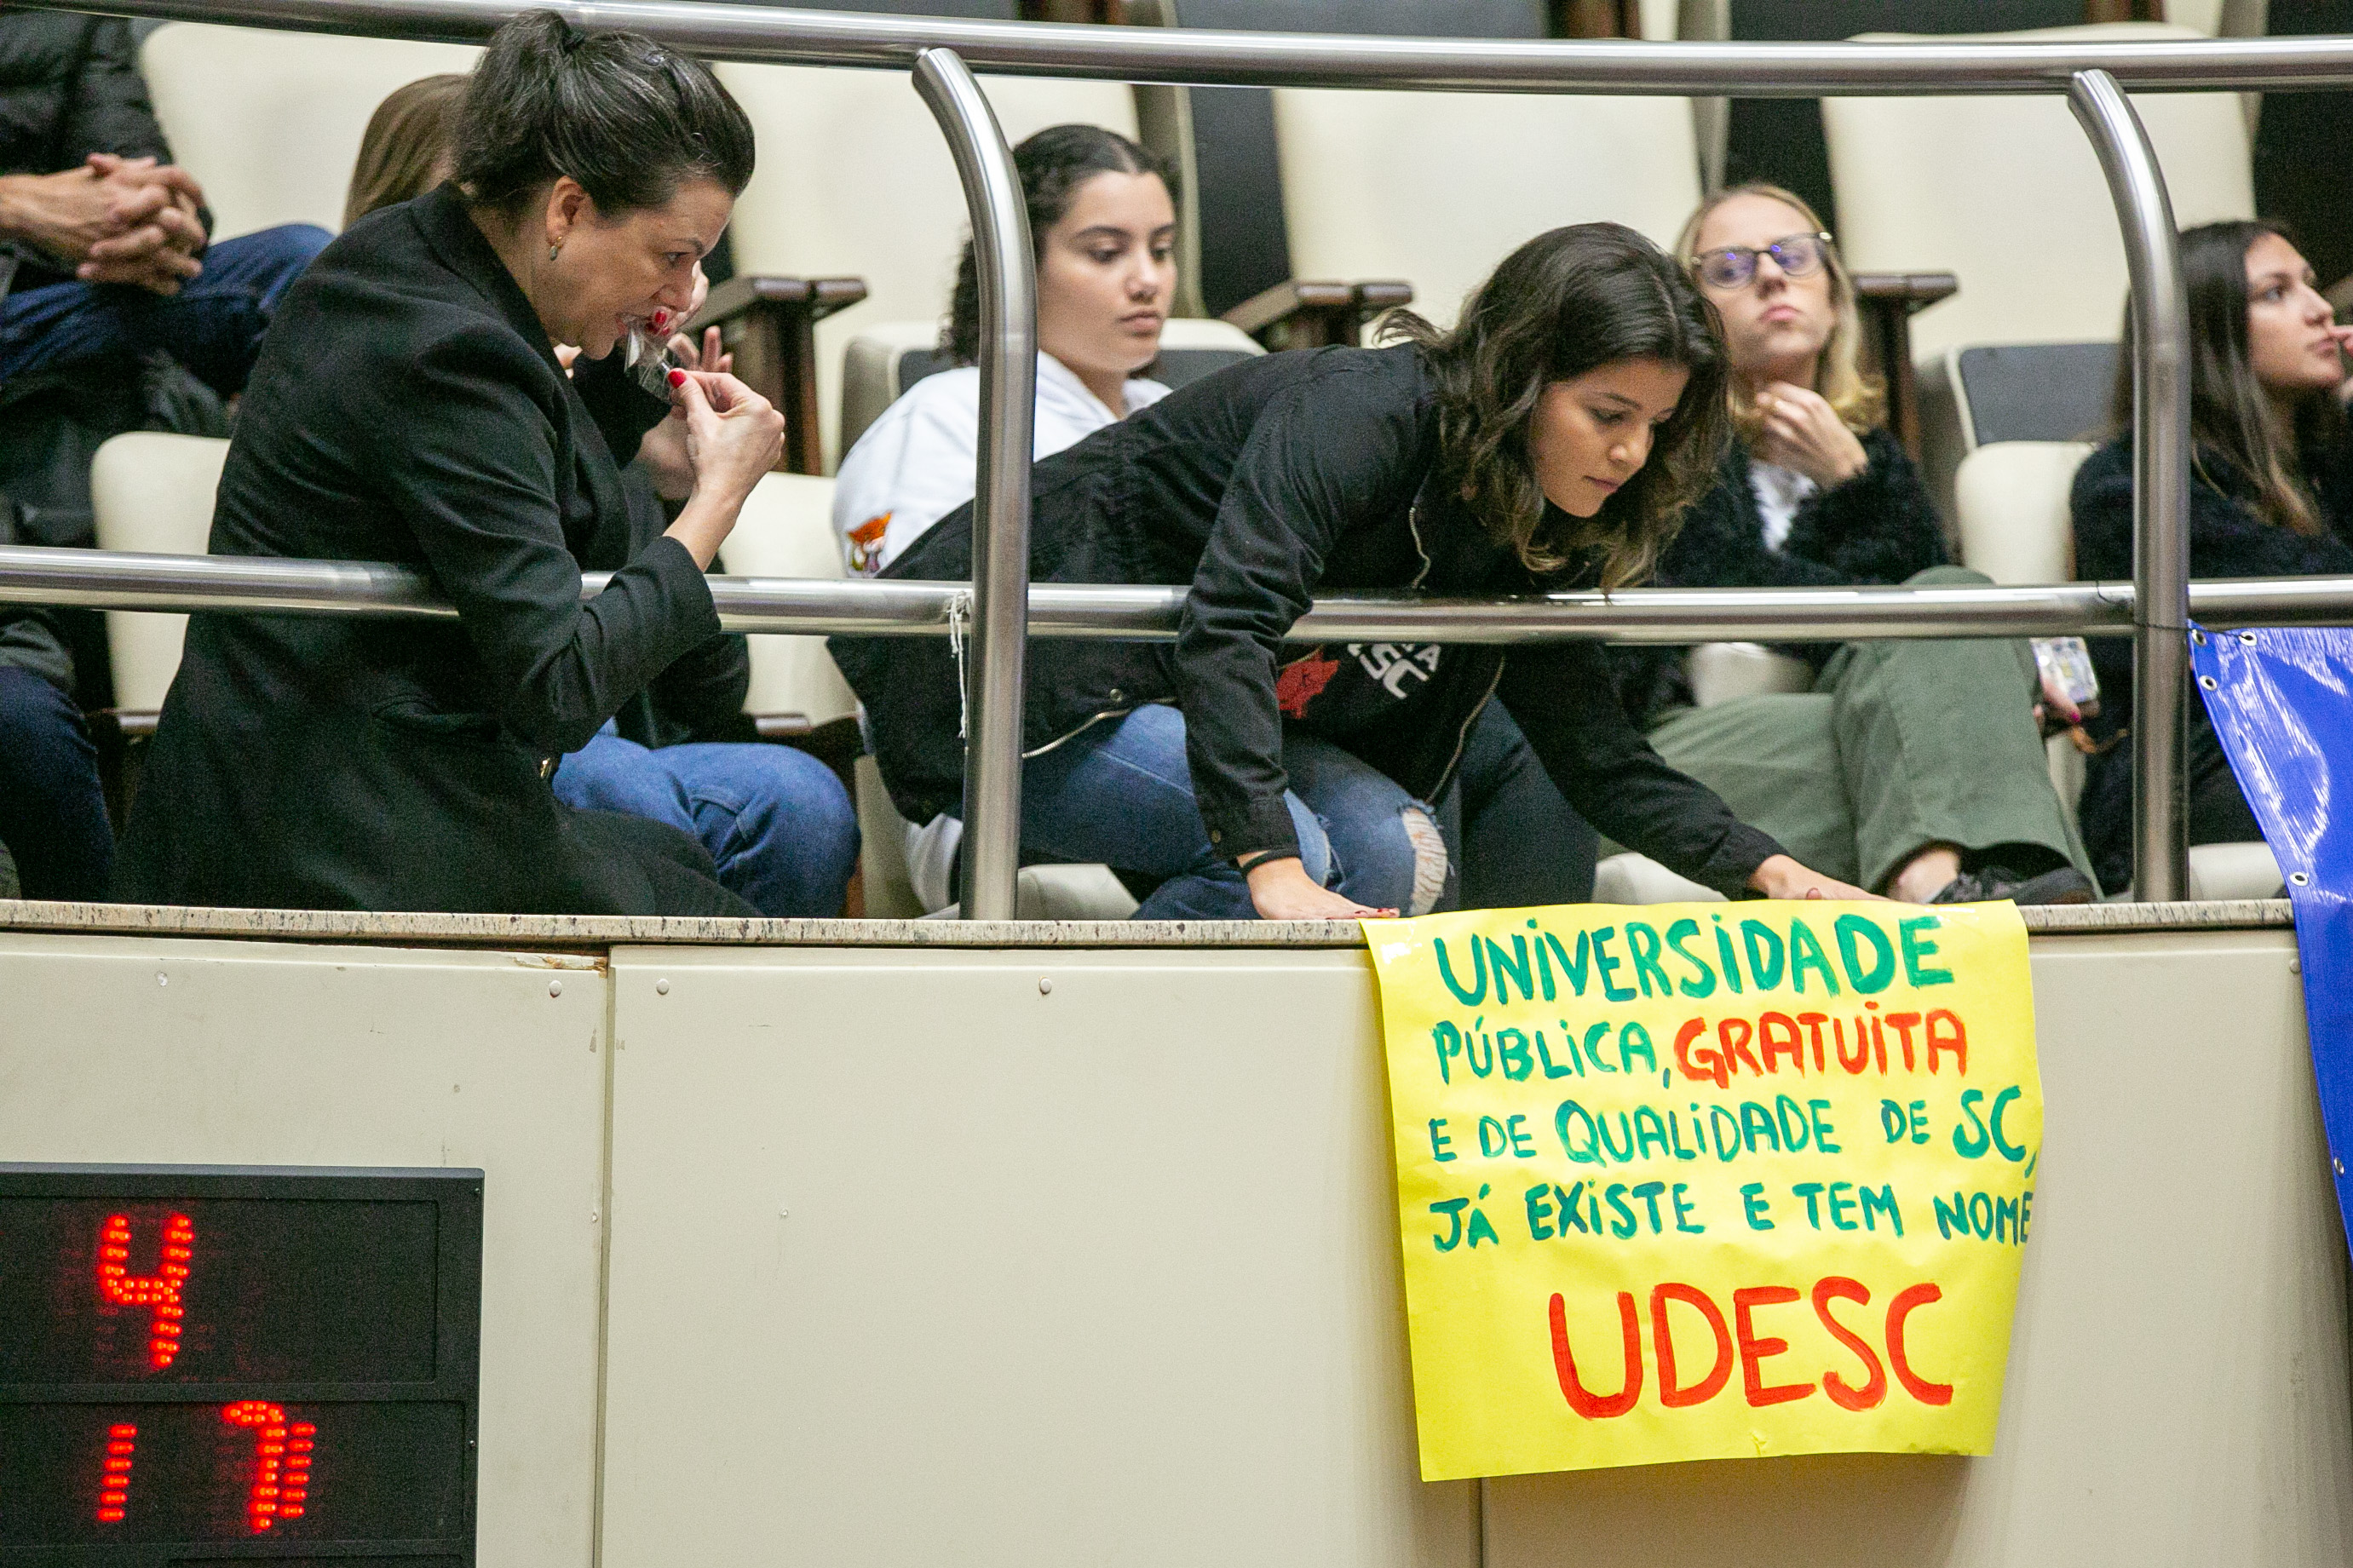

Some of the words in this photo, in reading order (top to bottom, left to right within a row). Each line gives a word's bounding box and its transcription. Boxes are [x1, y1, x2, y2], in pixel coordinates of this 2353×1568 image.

[1434, 913, 1954, 1008] UNIVERSIDADE
[1674, 1002, 1968, 1088] GRATUITA
[1428, 1117, 1457, 1163] E
[1479, 1115, 1537, 1158] DE
[1554, 1094, 1843, 1168] QUALIDADE
[1880, 1100, 1930, 1146] DE
[1952, 1084, 2037, 1179] SC,
[1429, 1183, 1500, 1254] JÁ
[1524, 1179, 1707, 1241] EXISTE
[1740, 1181, 1775, 1231] E
[1792, 1181, 1904, 1239] TEM
[1932, 1191, 2034, 1246] NOME
[96, 1211, 195, 1370] 4
[1549, 1276, 1953, 1420] UDESC
